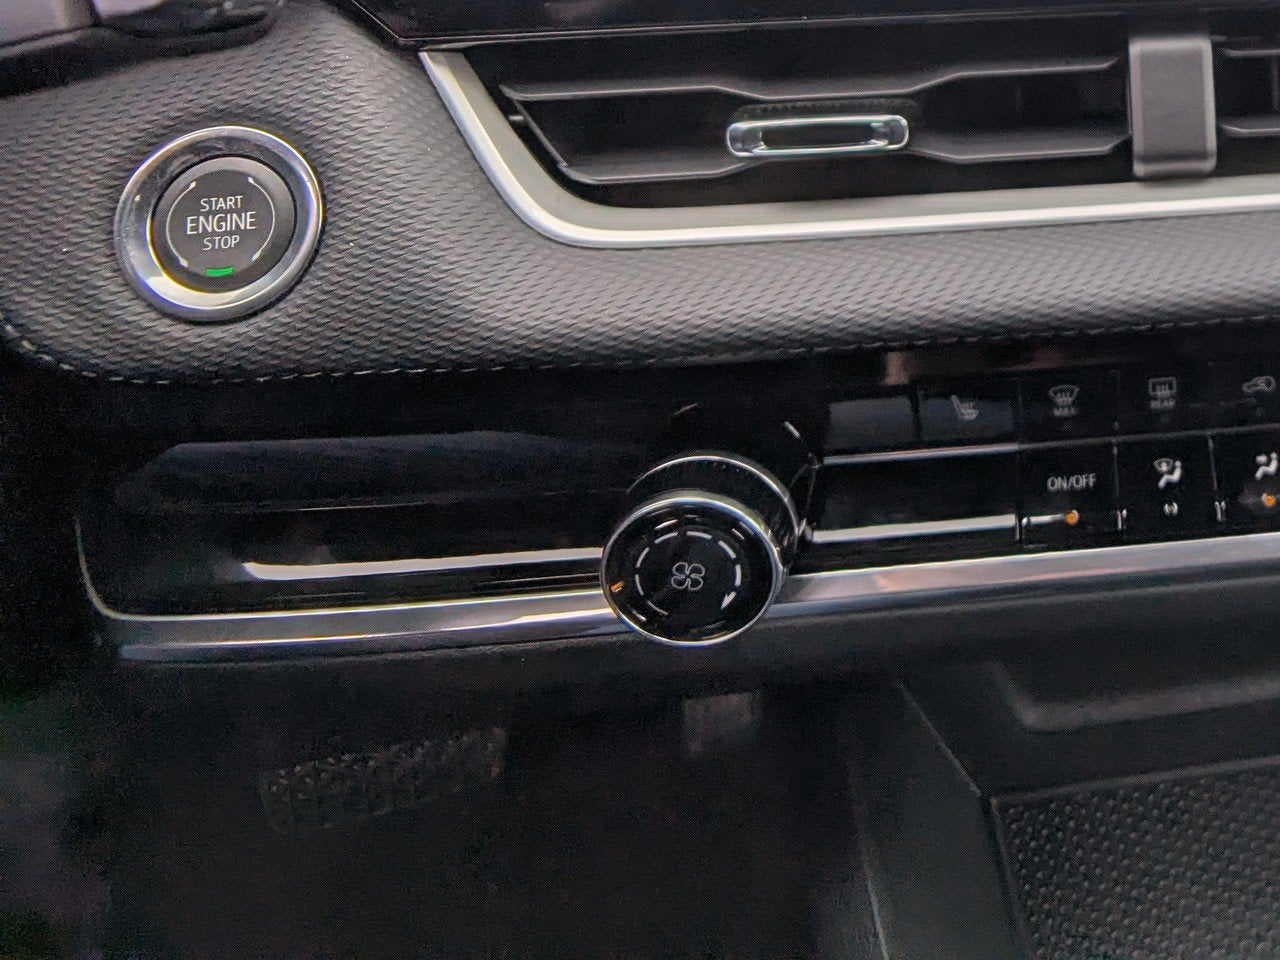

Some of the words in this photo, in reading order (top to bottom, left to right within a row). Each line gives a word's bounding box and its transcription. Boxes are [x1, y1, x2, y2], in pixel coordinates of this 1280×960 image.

[200, 195, 244, 212] START
[186, 211, 257, 235] ENGINE
[203, 235, 240, 251] STOP
[1047, 473, 1097, 491] ON/OFF
